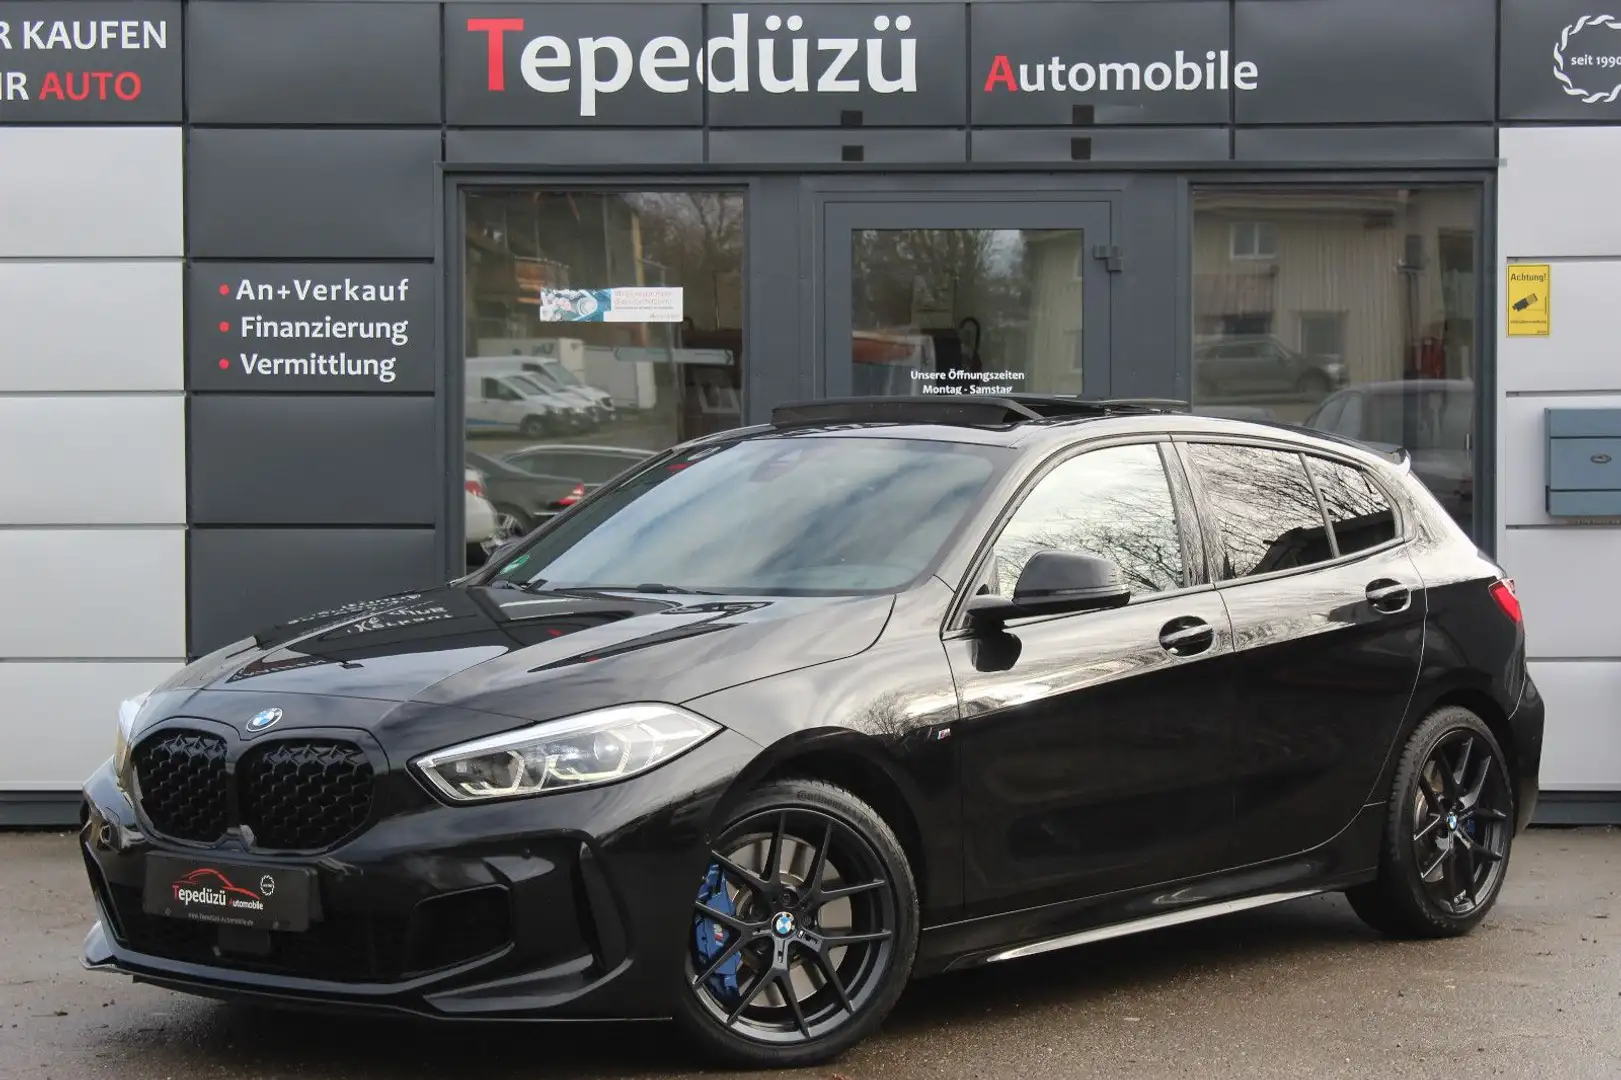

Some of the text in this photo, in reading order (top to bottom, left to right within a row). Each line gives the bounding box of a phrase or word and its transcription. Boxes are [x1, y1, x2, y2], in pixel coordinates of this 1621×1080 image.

[24, 20, 166, 49] KAUFEN
[467, 13, 1259, 117] Tepedüzü Automobile
[1571, 54, 1593, 65] seit
[39, 71, 142, 101] AUTO
[236, 278, 409, 301] An+Verkauf
[1510, 272, 1547, 282] Achtung!
[241, 315, 409, 346] Finanzierung
[240, 352, 396, 382] Vermittlung
[910, 368, 1025, 382] Unsere Öffnungszeiten
[922, 384, 962, 395] Montag
[969, 384, 1013, 395] Samstag
[172, 885, 264, 910] Tepedüzü Automobile
